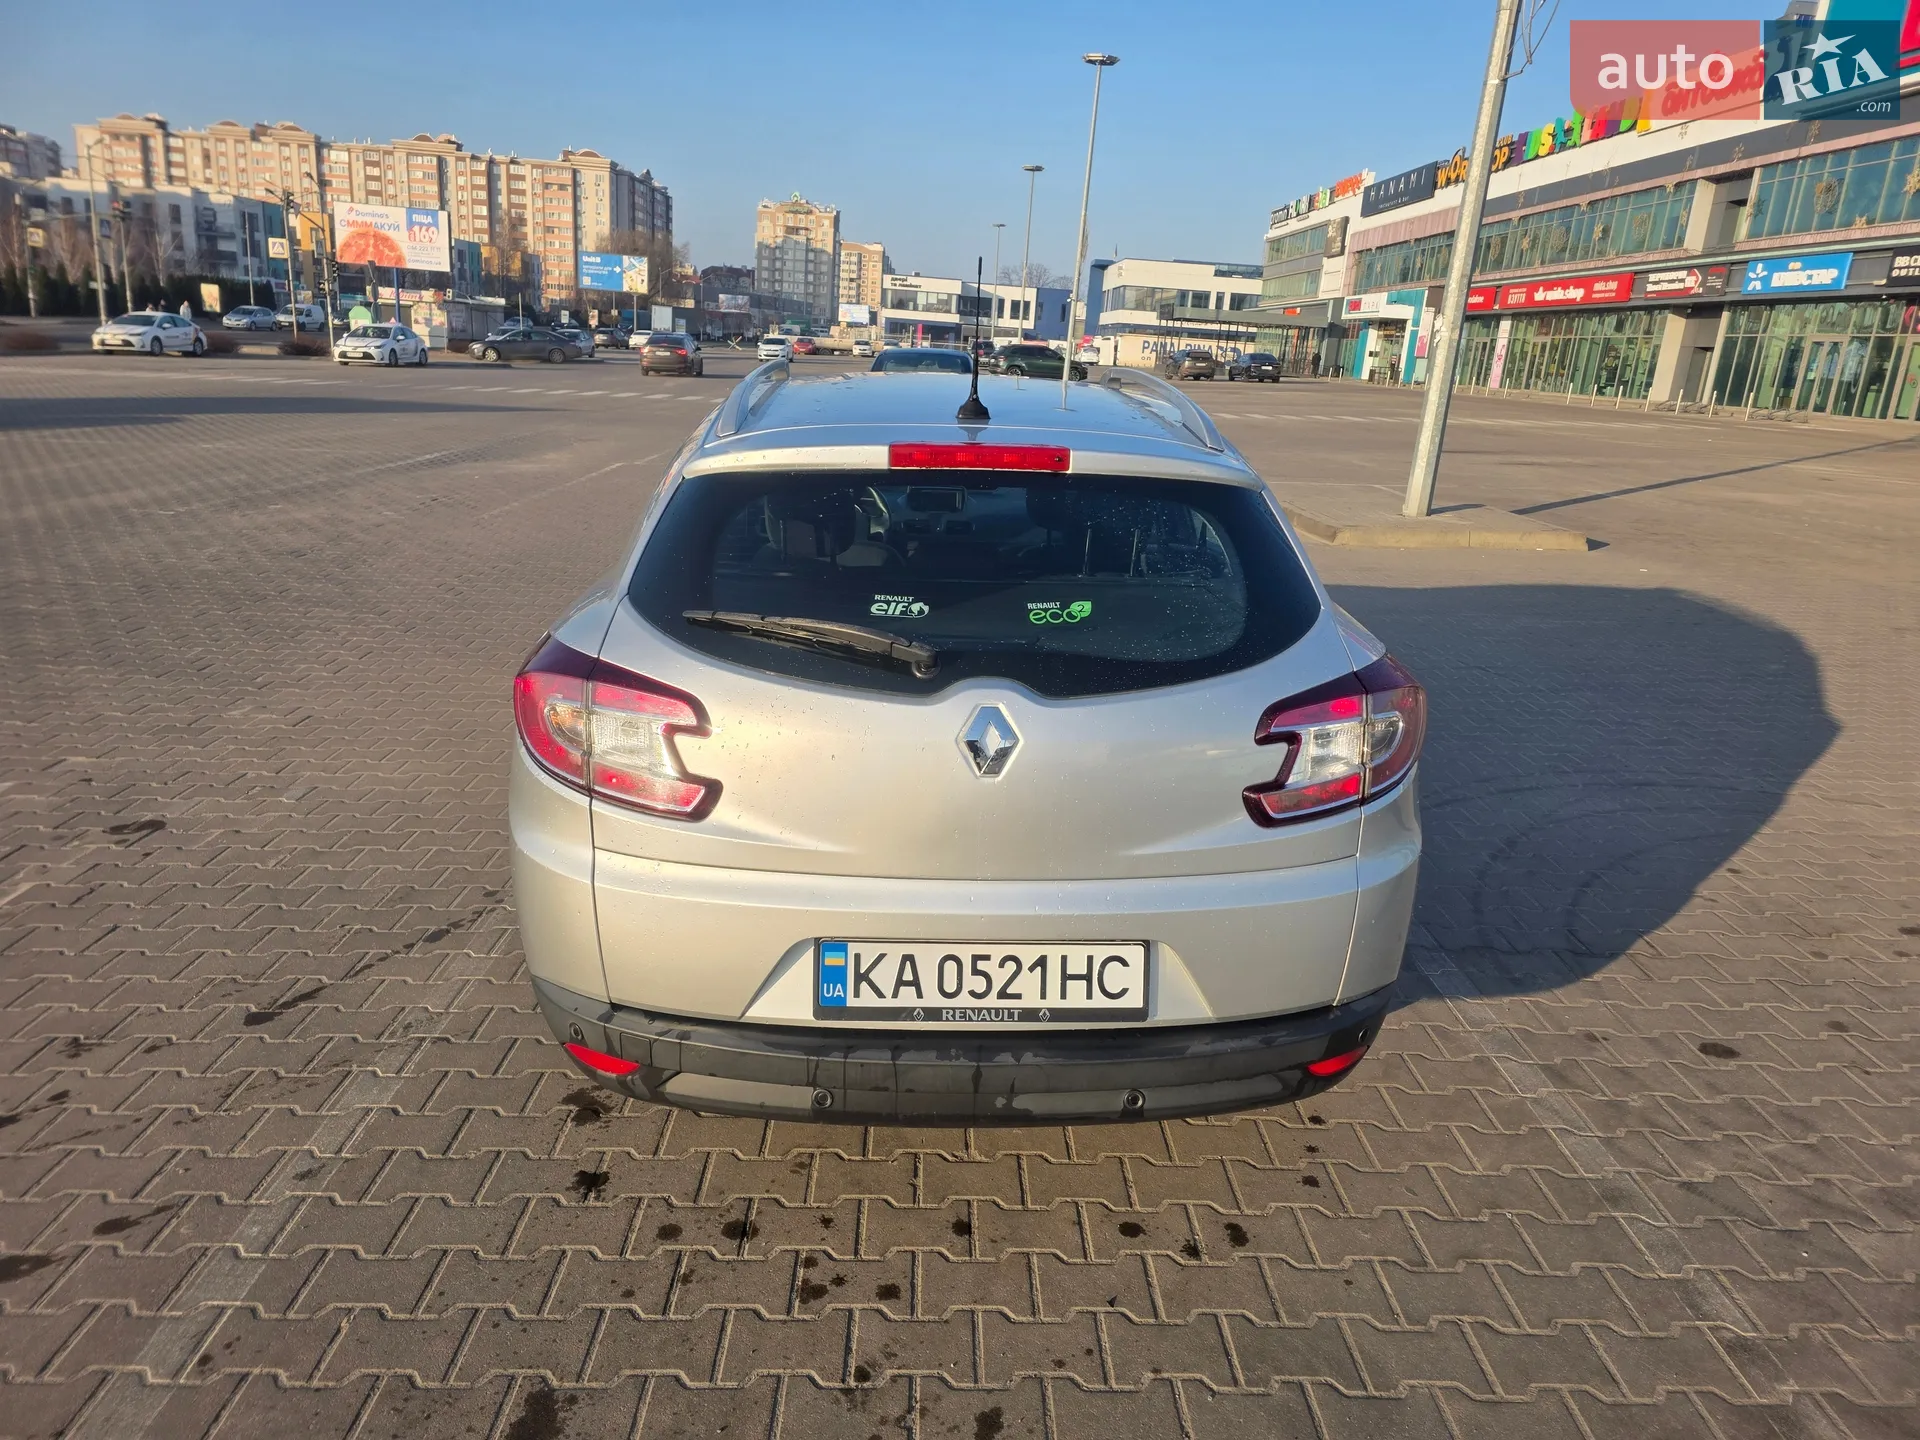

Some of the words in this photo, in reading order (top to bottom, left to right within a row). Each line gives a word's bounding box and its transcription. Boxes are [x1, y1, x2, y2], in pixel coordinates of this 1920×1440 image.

[1369, 168, 1426, 202] HANAMI
[355, 209, 389, 219] Domino's
[412, 213, 433, 224] ПІЦА
[339, 219, 400, 232] СМММАКУЙ
[413, 225, 438, 244] 169
[874, 594, 914, 602] RENAULT
[870, 601, 907, 617] elf
[1027, 601, 1061, 610] RENAULT
[852, 952, 924, 1000] KA
[937, 953, 1047, 1001] 0521
[1059, 954, 1131, 1001] HC
[823, 983, 845, 998] UA
[942, 1009, 1023, 1021] RENAULT
